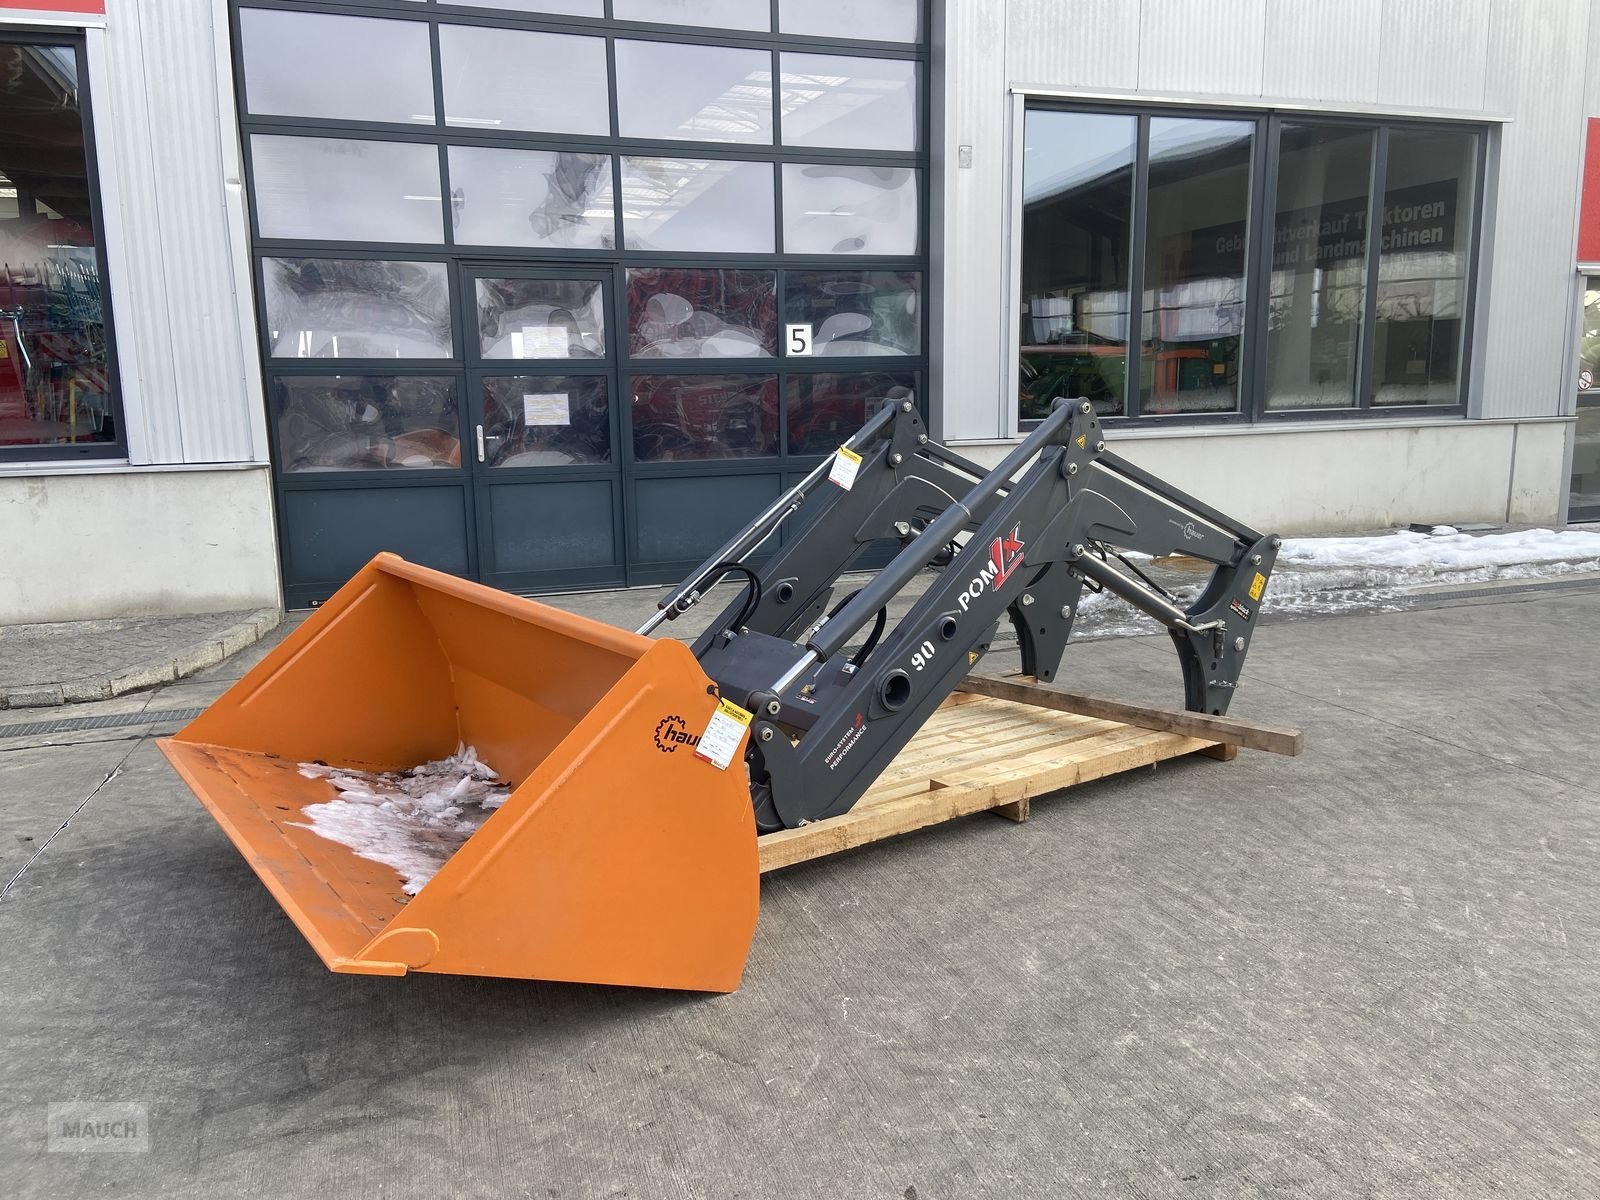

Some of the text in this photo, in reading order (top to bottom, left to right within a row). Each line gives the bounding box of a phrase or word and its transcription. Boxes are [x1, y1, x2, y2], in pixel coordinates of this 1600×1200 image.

[1354, 200, 1446, 230] Tktoren
[1304, 226, 1443, 262] Landmachinen
[791, 328, 806, 353] 5
[911, 640, 935, 671] 90
[824, 726, 855, 764] EURO-SYSTEM
[830, 724, 868, 770] PERFORMANCE
